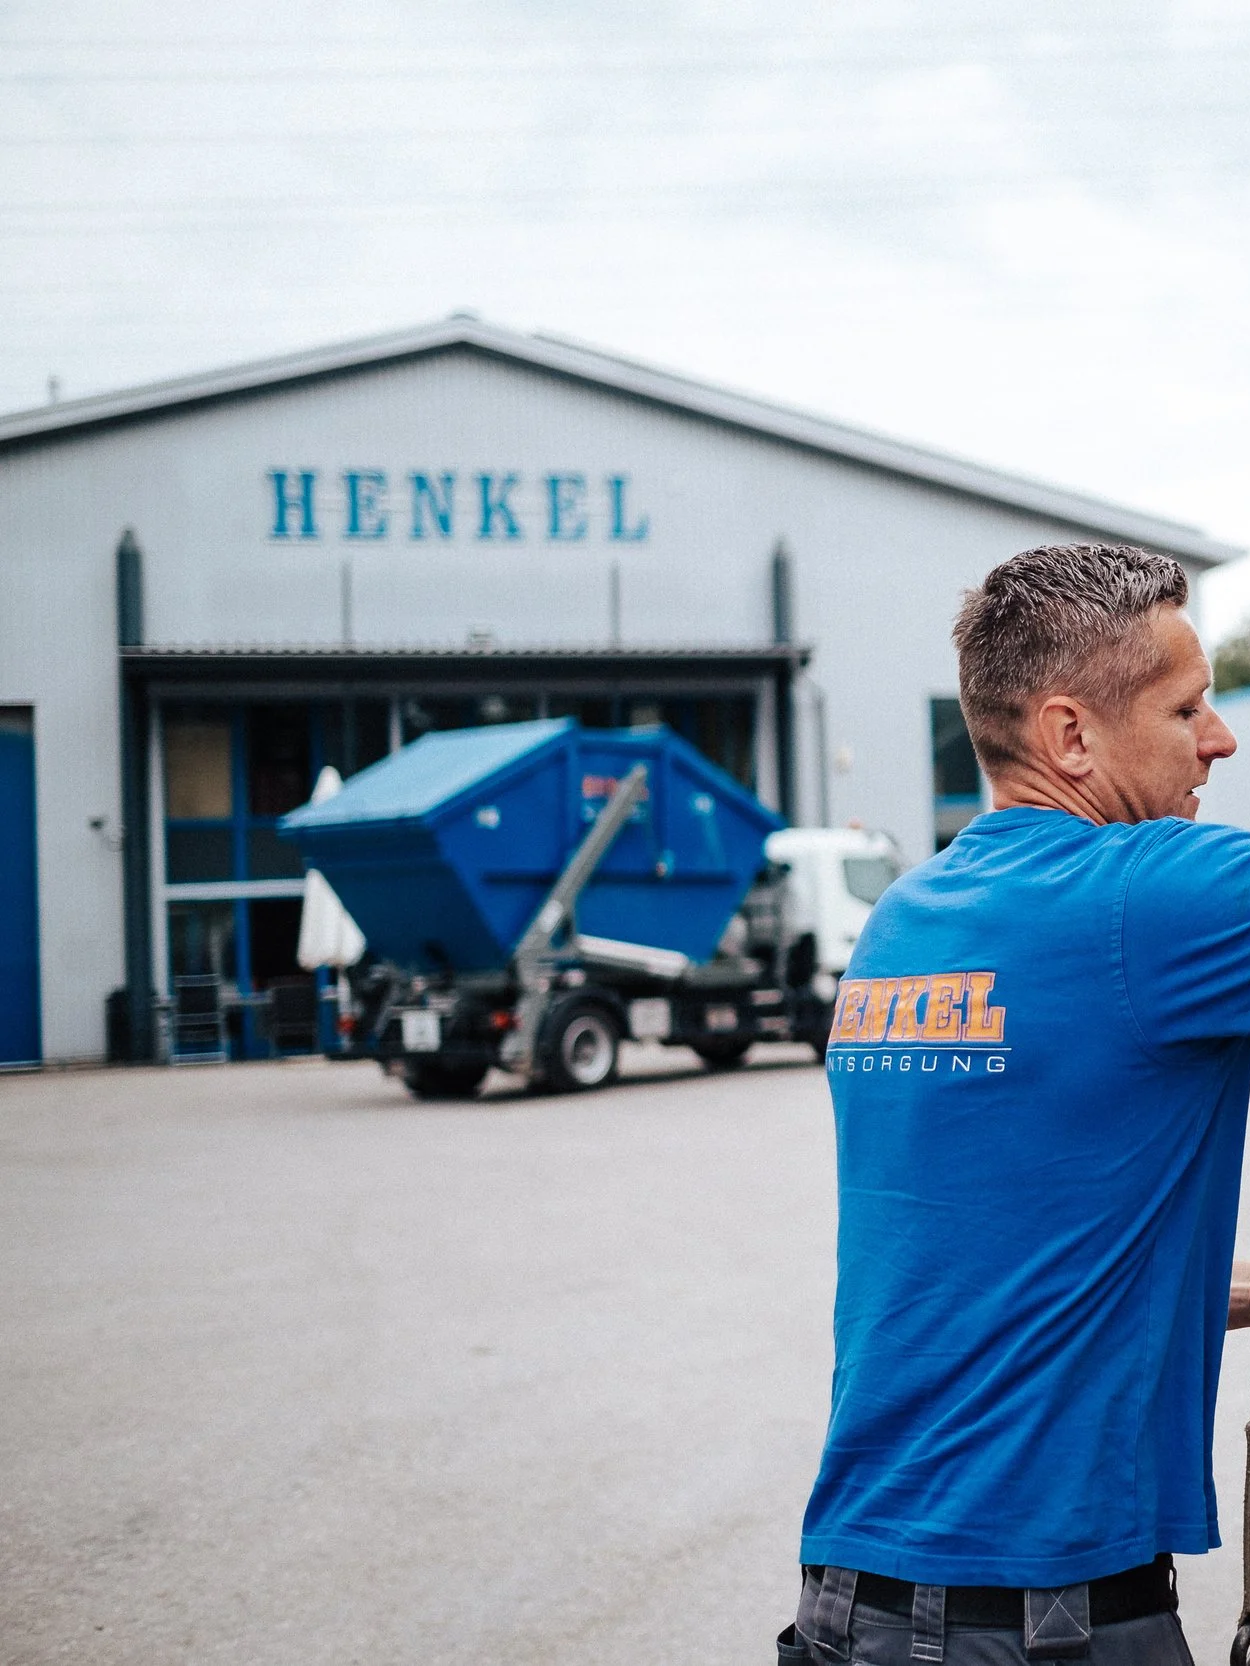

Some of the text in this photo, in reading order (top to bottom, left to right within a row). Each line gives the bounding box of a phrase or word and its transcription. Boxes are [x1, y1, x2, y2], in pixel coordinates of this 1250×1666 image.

[267, 468, 650, 542] HENKEL
[828, 972, 1006, 1043] ENKEL
[827, 1055, 1006, 1072] NTSORGUNG
